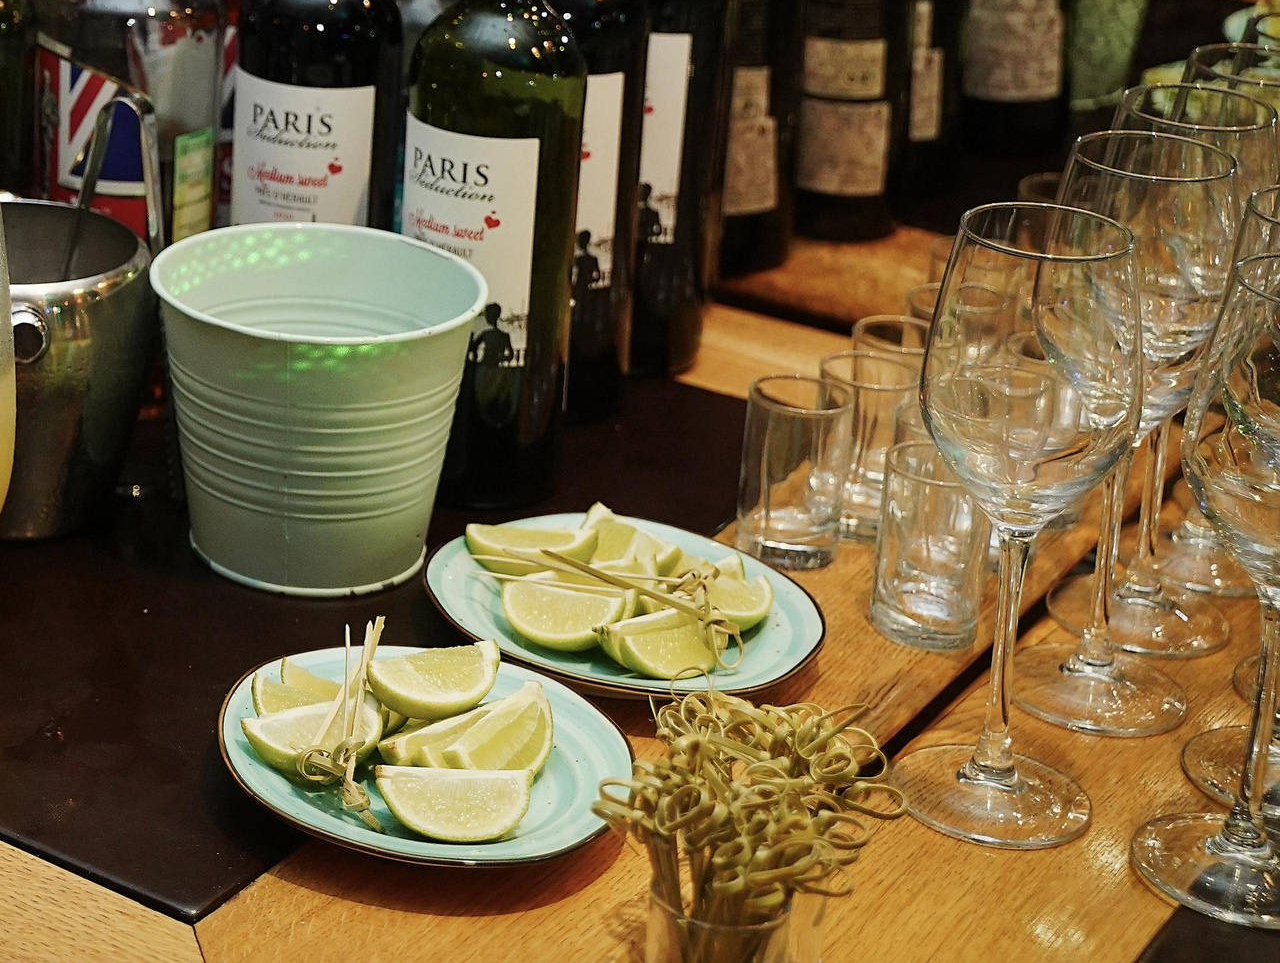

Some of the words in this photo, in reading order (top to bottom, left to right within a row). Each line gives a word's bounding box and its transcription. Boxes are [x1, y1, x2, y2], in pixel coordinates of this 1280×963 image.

[253, 102, 334, 137] PARIS
[297, 173, 329, 188] sweet
[409, 166, 496, 202] Seduction
[413, 146, 490, 188] PARIS
[452, 223, 485, 242] sweet
